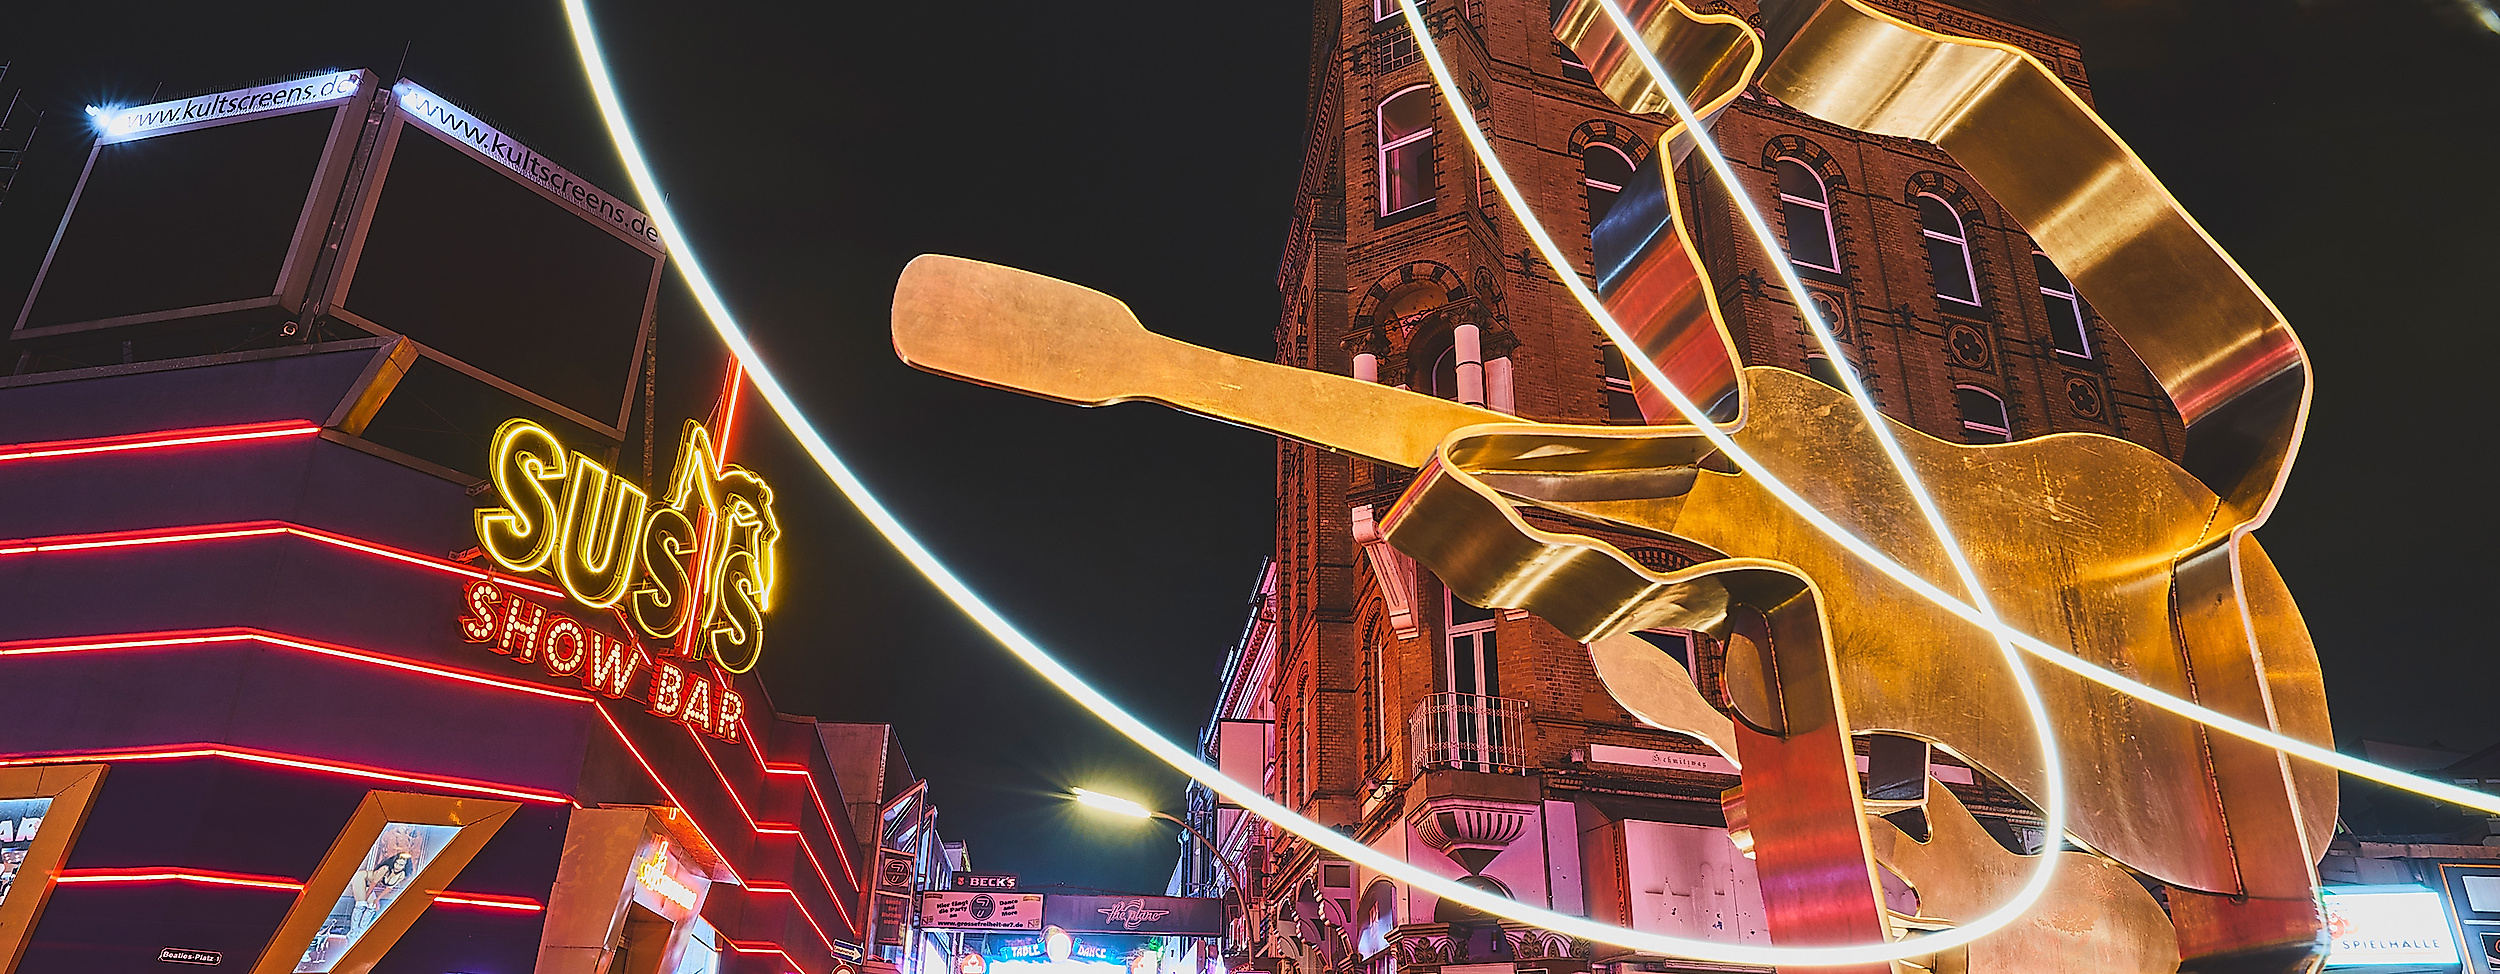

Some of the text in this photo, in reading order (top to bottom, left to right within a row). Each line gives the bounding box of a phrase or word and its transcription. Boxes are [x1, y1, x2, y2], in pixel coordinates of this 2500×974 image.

[462, 579, 745, 743] SHOW BAR
[969, 876, 1016, 889] BECK'S
[1011, 943, 1107, 959] TABLE DANCE
[2342, 939, 2441, 950] SPIELHALLE
